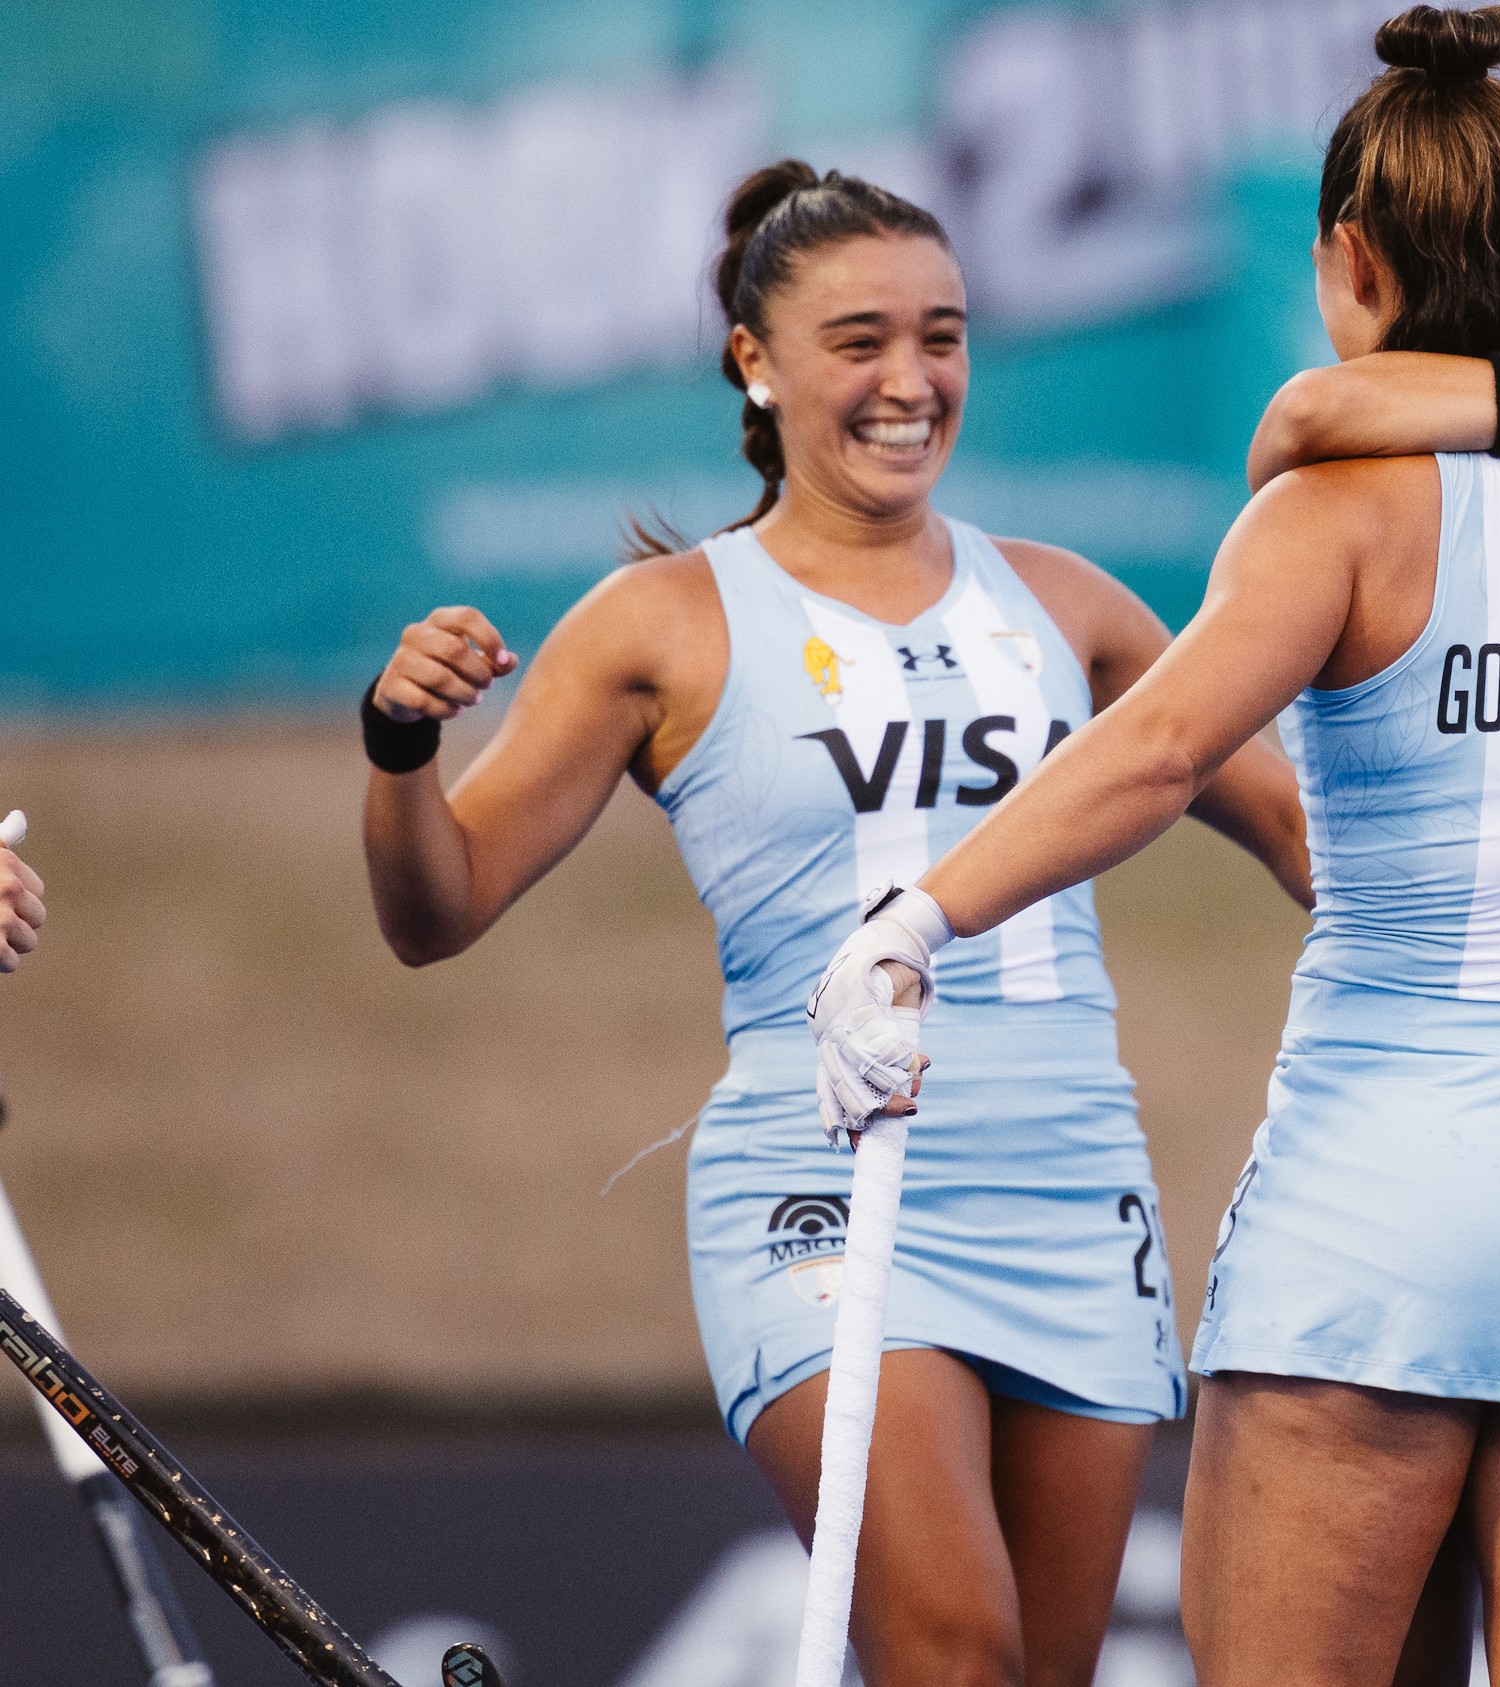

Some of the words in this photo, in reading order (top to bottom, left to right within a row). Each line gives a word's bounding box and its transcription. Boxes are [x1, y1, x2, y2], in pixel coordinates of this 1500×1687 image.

[770, 1236, 847, 1265] Macr
[0, 1316, 91, 1426] rabo
[91, 1424, 140, 1476] ELITE
